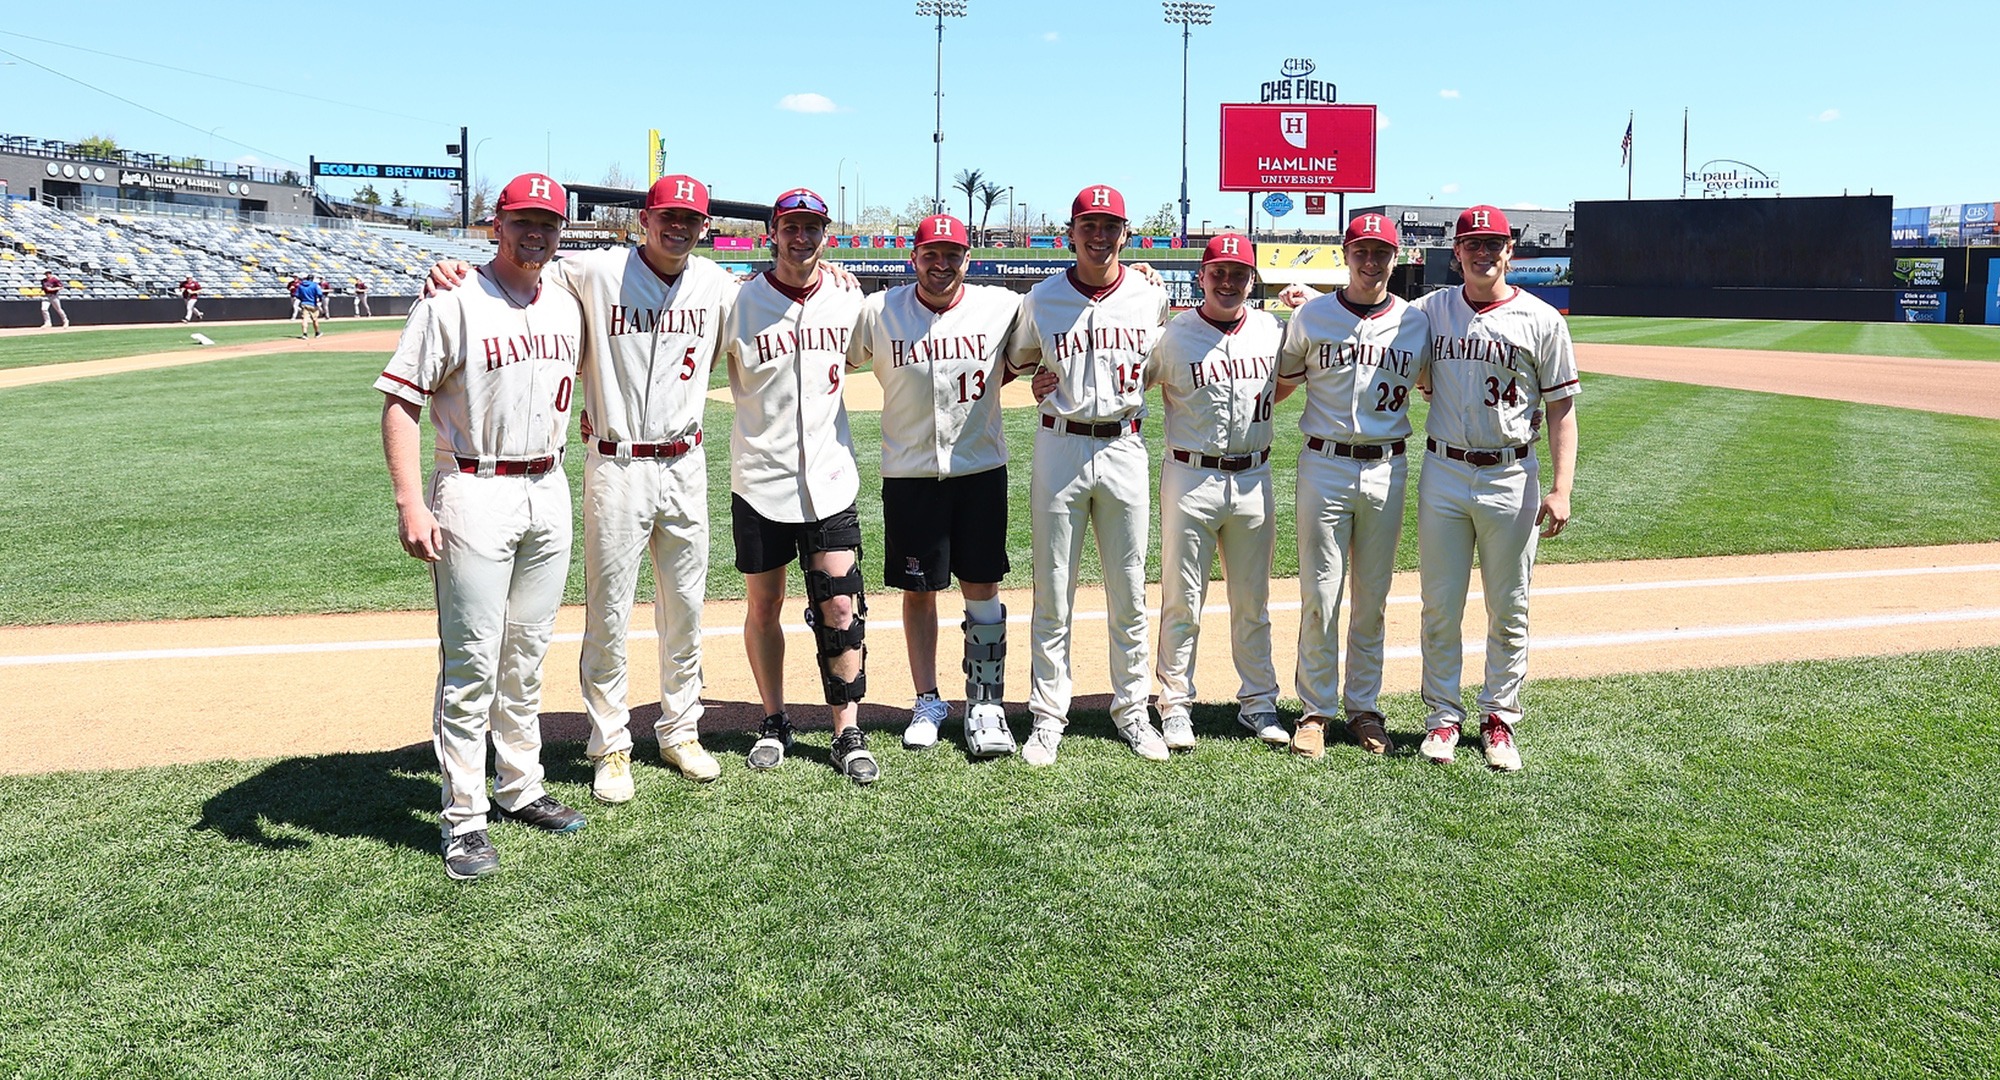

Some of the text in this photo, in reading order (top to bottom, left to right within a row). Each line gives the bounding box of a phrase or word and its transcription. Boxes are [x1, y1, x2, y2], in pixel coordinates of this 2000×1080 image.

[1283, 58, 1313, 71] CHS
[1261, 78, 1336, 103] CHS FIELD
[1285, 117, 1303, 134] H
[319, 163, 456, 179] ECOLAB BREW HUB
[1258, 157, 1337, 171] HAMLINE
[154, 174, 222, 189] CITY OF BASEBALL
[529, 177, 552, 200] H
[674, 179, 695, 202] H
[1260, 175, 1334, 184] UNIVERSITY
[1706, 177, 1779, 191] eye clinic
[1091, 188, 1111, 207] H
[934, 218, 952, 236] H
[1362, 215, 1382, 234] H
[1472, 210, 1491, 229] H
[560, 230, 610, 239] REWING PUB
[1220, 237, 1240, 255] H
[1914, 277, 1940, 285] below.
[609, 304, 707, 339] HAMLINE
[754, 327, 849, 365] HAMLINE
[890, 333, 988, 369] HAMLINE
[1053, 327, 1148, 363] HAMLINE
[1433, 334, 1520, 373] HAMLINE
[679, 346, 697, 381] 5
[1319, 342, 1414, 380] HAMLINE
[827, 363, 840, 395] 9
[956, 369, 987, 404] 13
[1116, 362, 1141, 394] 15
[555, 376, 572, 413] 0
[1374, 381, 1409, 413] 28
[1484, 376, 1518, 408] 34
[1251, 390, 1273, 423] 16
